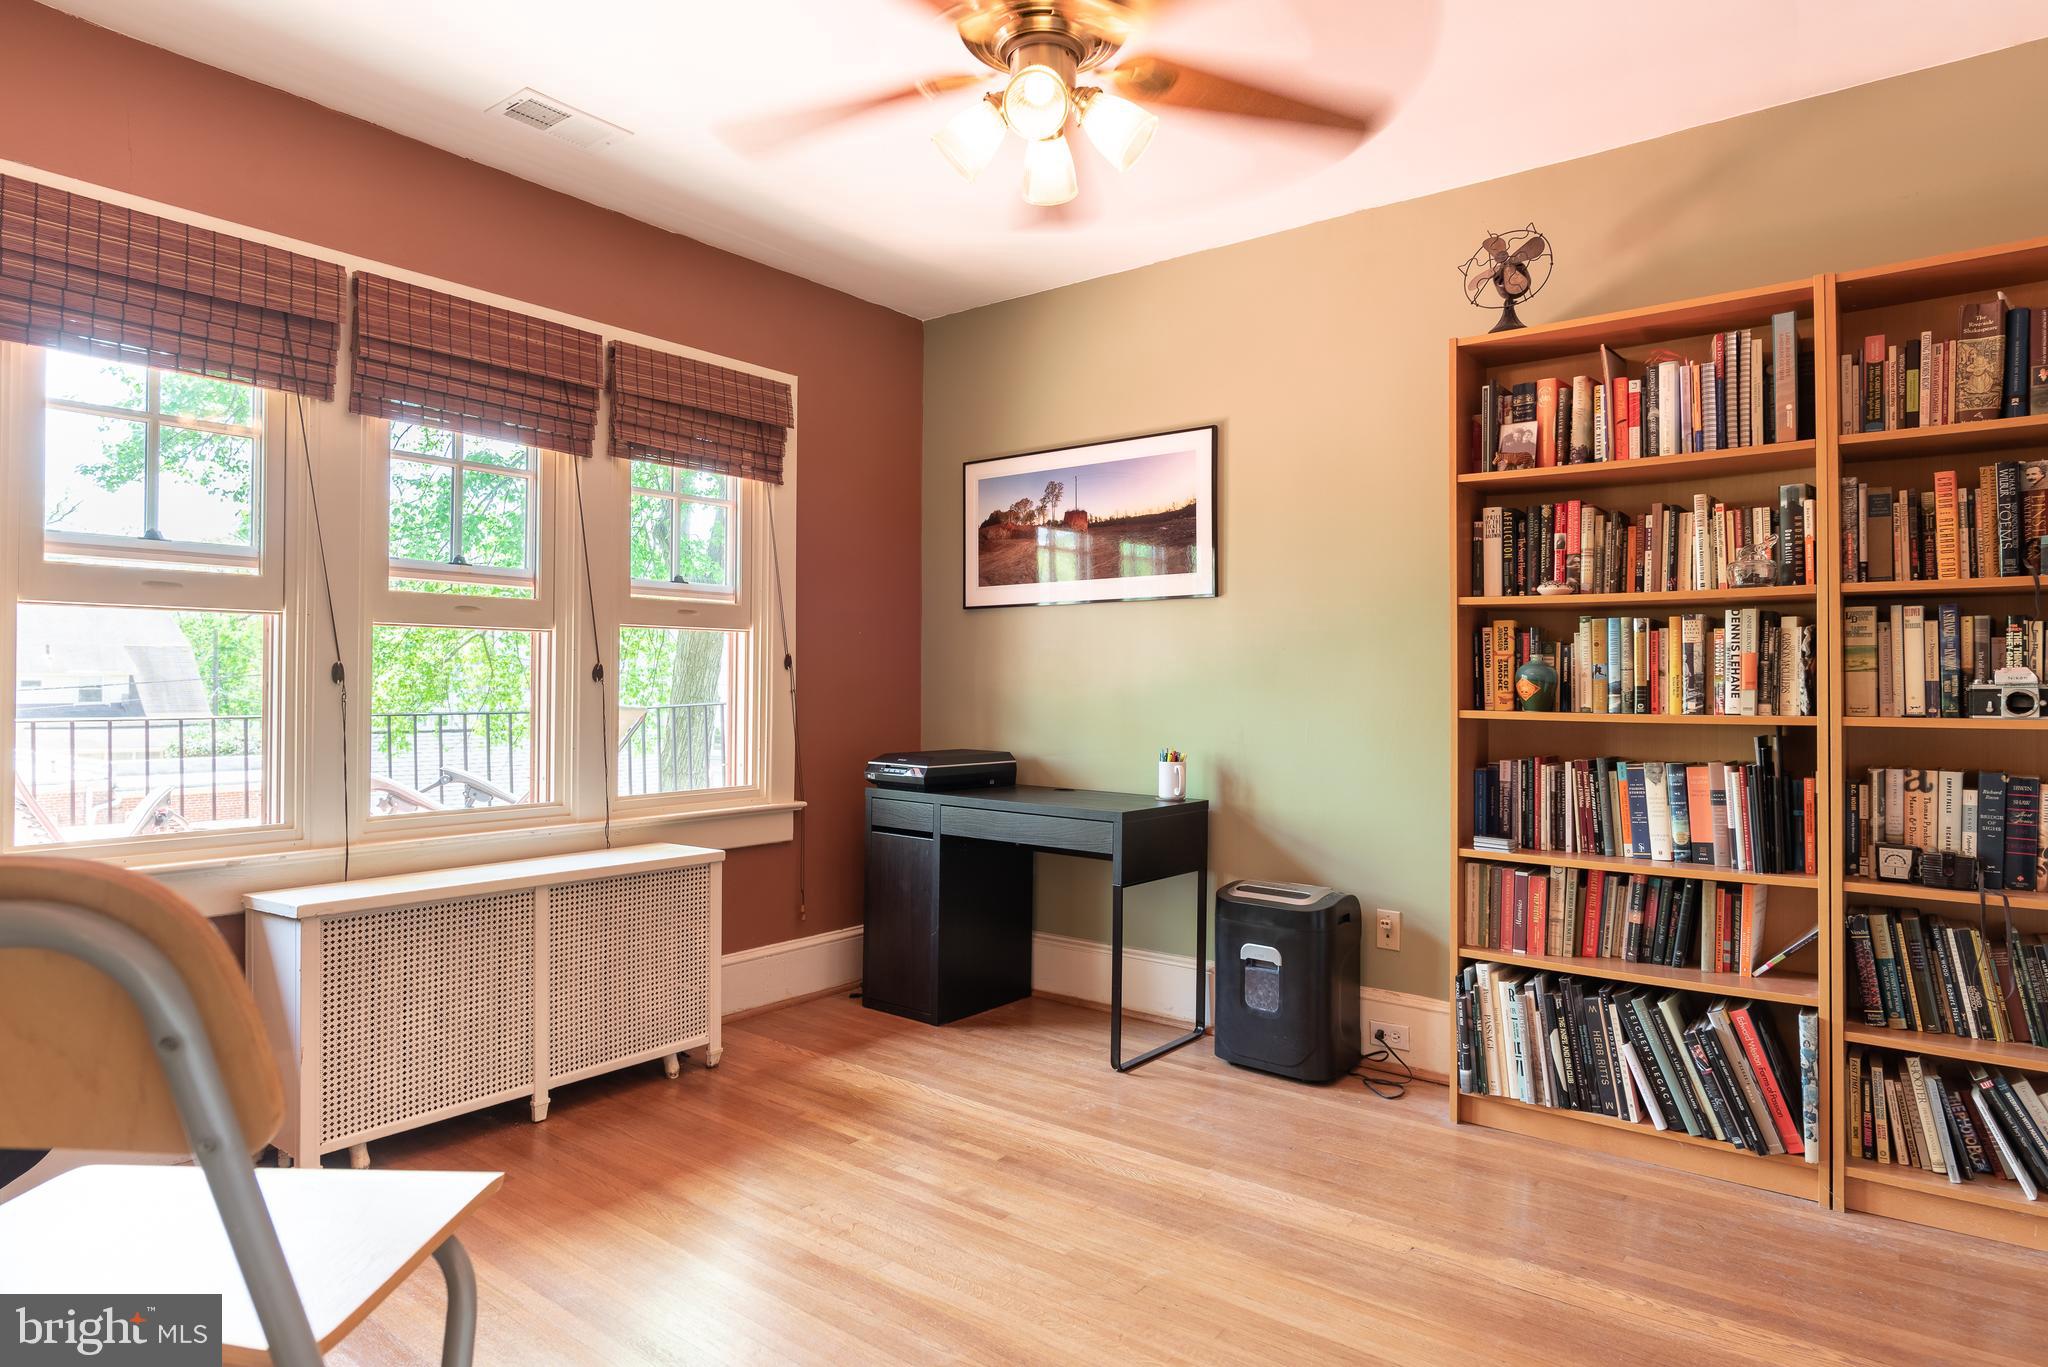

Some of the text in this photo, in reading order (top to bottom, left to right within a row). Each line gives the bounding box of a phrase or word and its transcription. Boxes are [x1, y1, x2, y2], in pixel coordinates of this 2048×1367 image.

[1963, 326, 1999, 334] Shakespeare
[1999, 469, 2009, 497] WILBUR
[1503, 511, 1513, 559] AFFLICTION
[1518, 537, 1526, 547] The
[1940, 518, 1955, 555] RICHARD
[1999, 503, 2013, 550] POEMS
[1784, 529, 1793, 565] Don DeLillo
[1795, 515, 1803, 577] UNDERWORLD
[1518, 563, 1526, 586] Hereafter
[1925, 553, 1934, 576] RUNNER
[1941, 557, 1956, 578] FORD
[1943, 613, 1956, 637] STRANGER
[1716, 639, 1724, 676] WOODSTOCK
[1731, 610, 1740, 699] DENNIS LEHANE
[1782, 633, 1792, 659] CARSON
[2014, 632, 2022, 668] THE THING
[1504, 680, 1509, 691] OF
[1909, 796, 1917, 816] Mason
[1922, 797, 1931, 846] Thomas Pynchon
[1479, 969, 1488, 988] Irving
[1933, 928, 1960, 1023] SUN UNDER WOOD Robert Hass
[1483, 1014, 1494, 1051] PASSAGE
[1655, 1014, 1664, 1033] EDWARD
[1664, 1033, 1673, 1055] STEICHEN
[1563, 1058, 1571, 1068] GUN
[1592, 1030, 1609, 1086] HERB RITTS
[1607, 1027, 1622, 1084] FIDEL'S CUBA
[1625, 1003, 1672, 1106] STEICHEN'S LEGACY
[1736, 1016, 1750, 1041] Edward
[1747, 1042, 1761, 1066] Weston
[1759, 1067, 1769, 1087] Forms
[1769, 1094, 1784, 1118] Passion
[1850, 1060, 1858, 1075] FAST
[1565, 1070, 1574, 1084] CLUB
[1737, 1061, 1756, 1104] WEEGEE'S WORLD
[1909, 1061, 1927, 1103] SHOOTER
[1980, 1080, 1994, 1089] LIFE
[1949, 1091, 1966, 1112] THE
[2004, 1092, 2043, 1146] INTERVIEWS WITH MASTER
